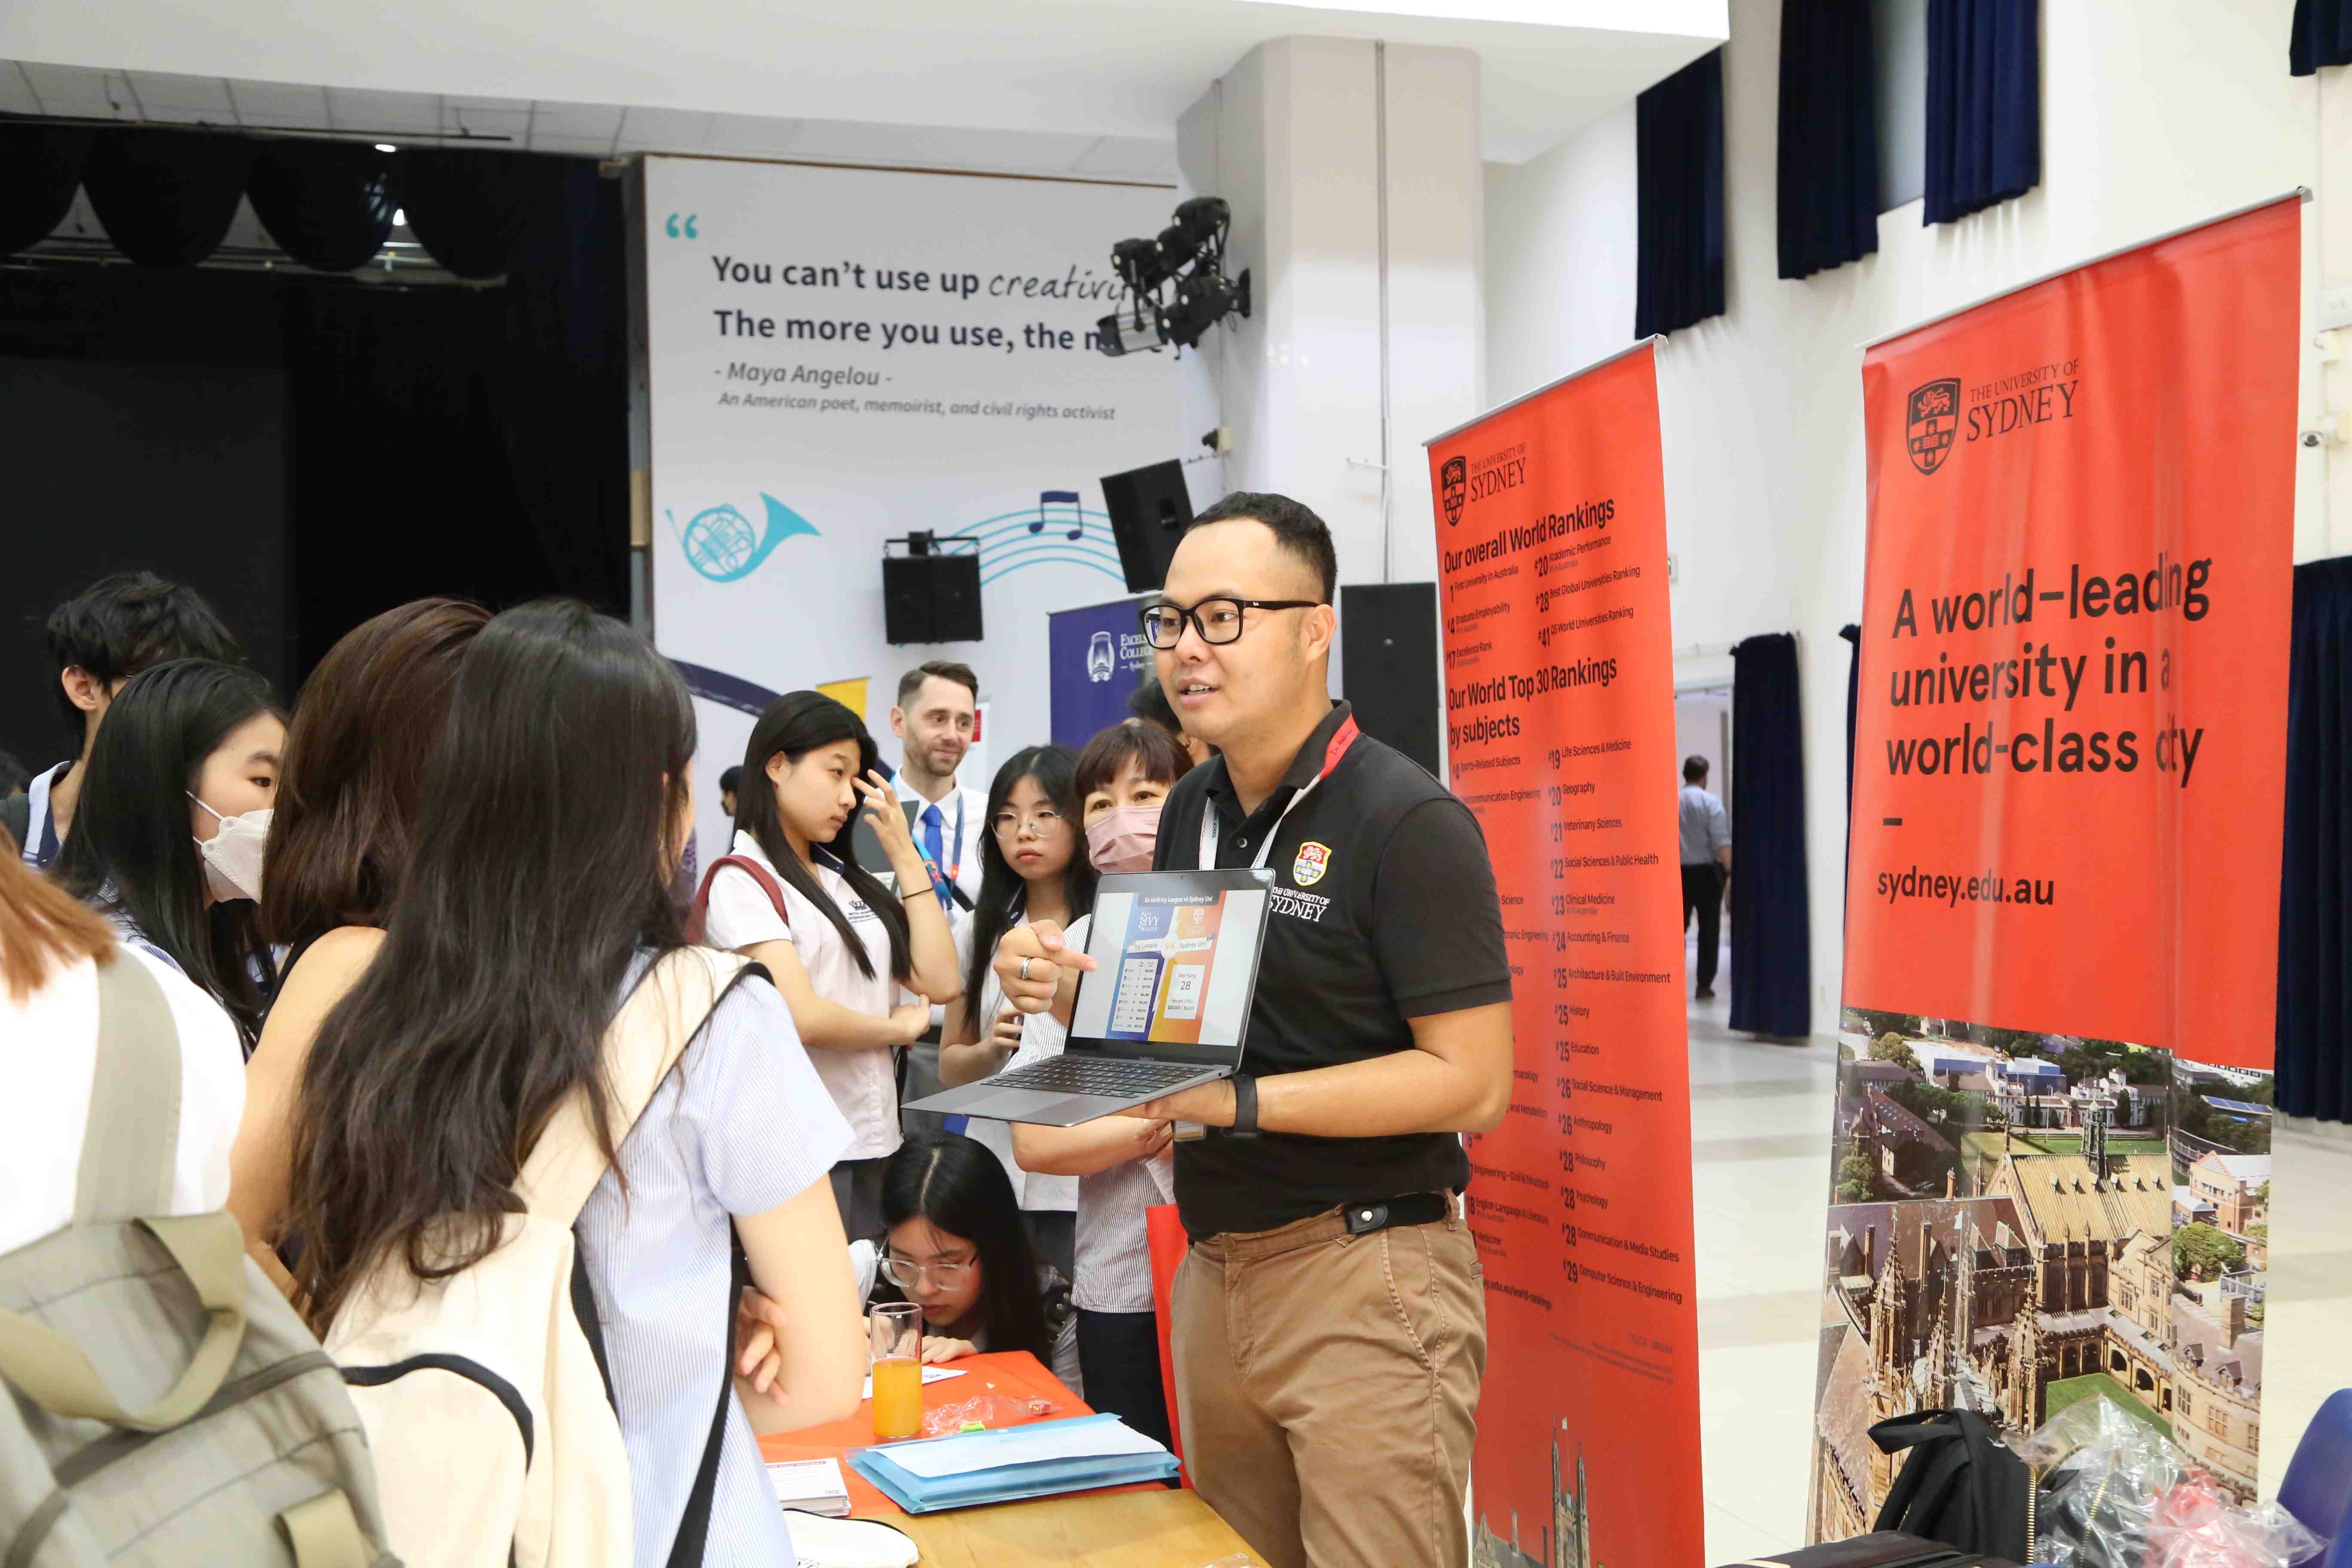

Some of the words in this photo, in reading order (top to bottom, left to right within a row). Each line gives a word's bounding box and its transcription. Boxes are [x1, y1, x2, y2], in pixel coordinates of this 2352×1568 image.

[712, 257, 772, 284] You
[784, 261, 865, 289] can't
[876, 270, 930, 292] use
[940, 270, 979, 300] up
[714, 310, 775, 338] The
[787, 318, 870, 341] more
[882, 322, 938, 349] you
[951, 325, 1014, 353] use,
[1024, 323, 1074, 349] the
[727, 363, 786, 385] Maya
[791, 366, 879, 389] Angelou
[1970, 385, 1992, 402] THE
[1995, 363, 2059, 396] UNIVERSITY
[2063, 359, 2079, 375] OF
[718, 392, 739, 406] An
[743, 394, 816, 410] American
[820, 397, 859, 413] poet,
[864, 399, 945, 416] memoirist,
[950, 402, 979, 416] and
[982, 402, 1011, 417] civil
[1015, 404, 1059, 420] rights
[1063, 406, 1115, 420] activist
[1967, 380, 2079, 442] SYDNEY
[1471, 460, 1481, 473] THE
[1483, 447, 1516, 469] UNIVERSITY
[1517, 443, 1525, 454] OF
[1471, 457, 1526, 502] SYDNEY
[1445, 550, 1462, 573] Our
[1465, 530, 1507, 567] overall
[1509, 516, 1546, 552] World
[1549, 499, 1614, 540] Rankings
[1549, 547, 1575, 562] Academic
[1577, 536, 1611, 554] Performance
[1465, 573, 1488, 589] University
[1488, 573, 1493, 582] in
[1494, 565, 1519, 579] Australia
[1550, 586, 1561, 599] Best
[1562, 581, 1580, 595] Global
[1581, 572, 1612, 590] Universities
[1613, 566, 1641, 581] Ranking
[1455, 611, 1475, 625] Graduate
[1475, 602, 1511, 620] Employability
[1550, 623, 1558, 636] QS
[1558, 619, 1575, 634] World
[1575, 612, 1608, 629] Universities
[1609, 606, 1634, 621] Ranking
[1892, 588, 1918, 639] A
[1456, 646, 1479, 658] Excellence
[1479, 641, 1493, 653] Rank
[1449, 687, 1466, 711] Our
[1467, 676, 1506, 706] World
[1508, 674, 1534, 701] Top
[1536, 668, 1549, 695] 30
[1551, 657, 1617, 690] Rankings
[1890, 641, 2087, 711] university
[2104, 636, 2147, 694] in
[2161, 648, 2170, 691] a
[1450, 721, 1461, 750] by
[1463, 714, 1520, 746] subjects
[1562, 747, 1572, 758] Life
[1573, 744, 1600, 757] Sciences
[1601, 742, 1605, 753] &
[1606, 739, 1631, 752] Medicine
[1886, 717, 2139, 775] world-class
[2156, 712, 2204, 789] city
[1496, 755, 1521, 768] Subjects
[1510, 788, 1541, 802] Engineering
[1562, 781, 1596, 796] Geography
[1596, 817, 1622, 829] Sciences
[1564, 857, 1582, 868] Social
[1583, 855, 1610, 867] Sciences
[1615, 854, 1634, 867] Public
[1634, 853, 1659, 866] Health
[1273, 886, 1284, 895] THE
[1283, 888, 1320, 903] UNIVERSITY
[1319, 897, 1331, 906] OF
[1877, 865, 2055, 908] sydney.edu.au
[1167, 896, 1183, 904] League
[1189, 895, 1204, 904] Sydney
[1501, 894, 1524, 905] Science
[1566, 894, 1586, 905] Clinical
[1587, 893, 1616, 905] Medicine
[1145, 916, 1160, 926] IVY
[1521, 929, 1549, 942] Engineering
[1567, 930, 1601, 945] Accounting
[1602, 932, 1607, 943] &
[1607, 931, 1629, 943] Finance
[1180, 981, 1191, 990] 28
[1568, 966, 1605, 981] Architecture
[1606, 969, 1611, 981] &
[1611, 970, 1624, 982] Built
[1625, 970, 1671, 984] Environment
[1569, 1004, 1590, 1019] History
[1571, 1041, 1599, 1056] Education
[1572, 1079, 1588, 1093] Social
[1589, 1081, 1614, 1096] Science
[1614, 1084, 1619, 1096] &
[1619, 1085, 1663, 1102] Management
[1510, 1103, 1520, 1113] and
[1573, 1116, 1613, 1135] Anthropology
[1574, 1152, 1606, 1170] Philosophy
[1474, 1164, 1507, 1181] Engineering
[1510, 1170, 1521, 1182] Civil
[1476, 1197, 1495, 1211] English
[1495, 1203, 1522, 1219] Language
[1576, 1189, 1608, 1210] Psychology
[1477, 1231, 1502, 1246] Medicine
[1577, 1227, 1623, 1250] Communication
[1624, 1240, 1629, 1251] &
[1629, 1240, 1649, 1258] Media
[1650, 1246, 1679, 1262] Studies
[1579, 1265, 1607, 1283] Computer
[1607, 1273, 1632, 1291] Science
[1638, 1281, 1682, 1305] Engineering
